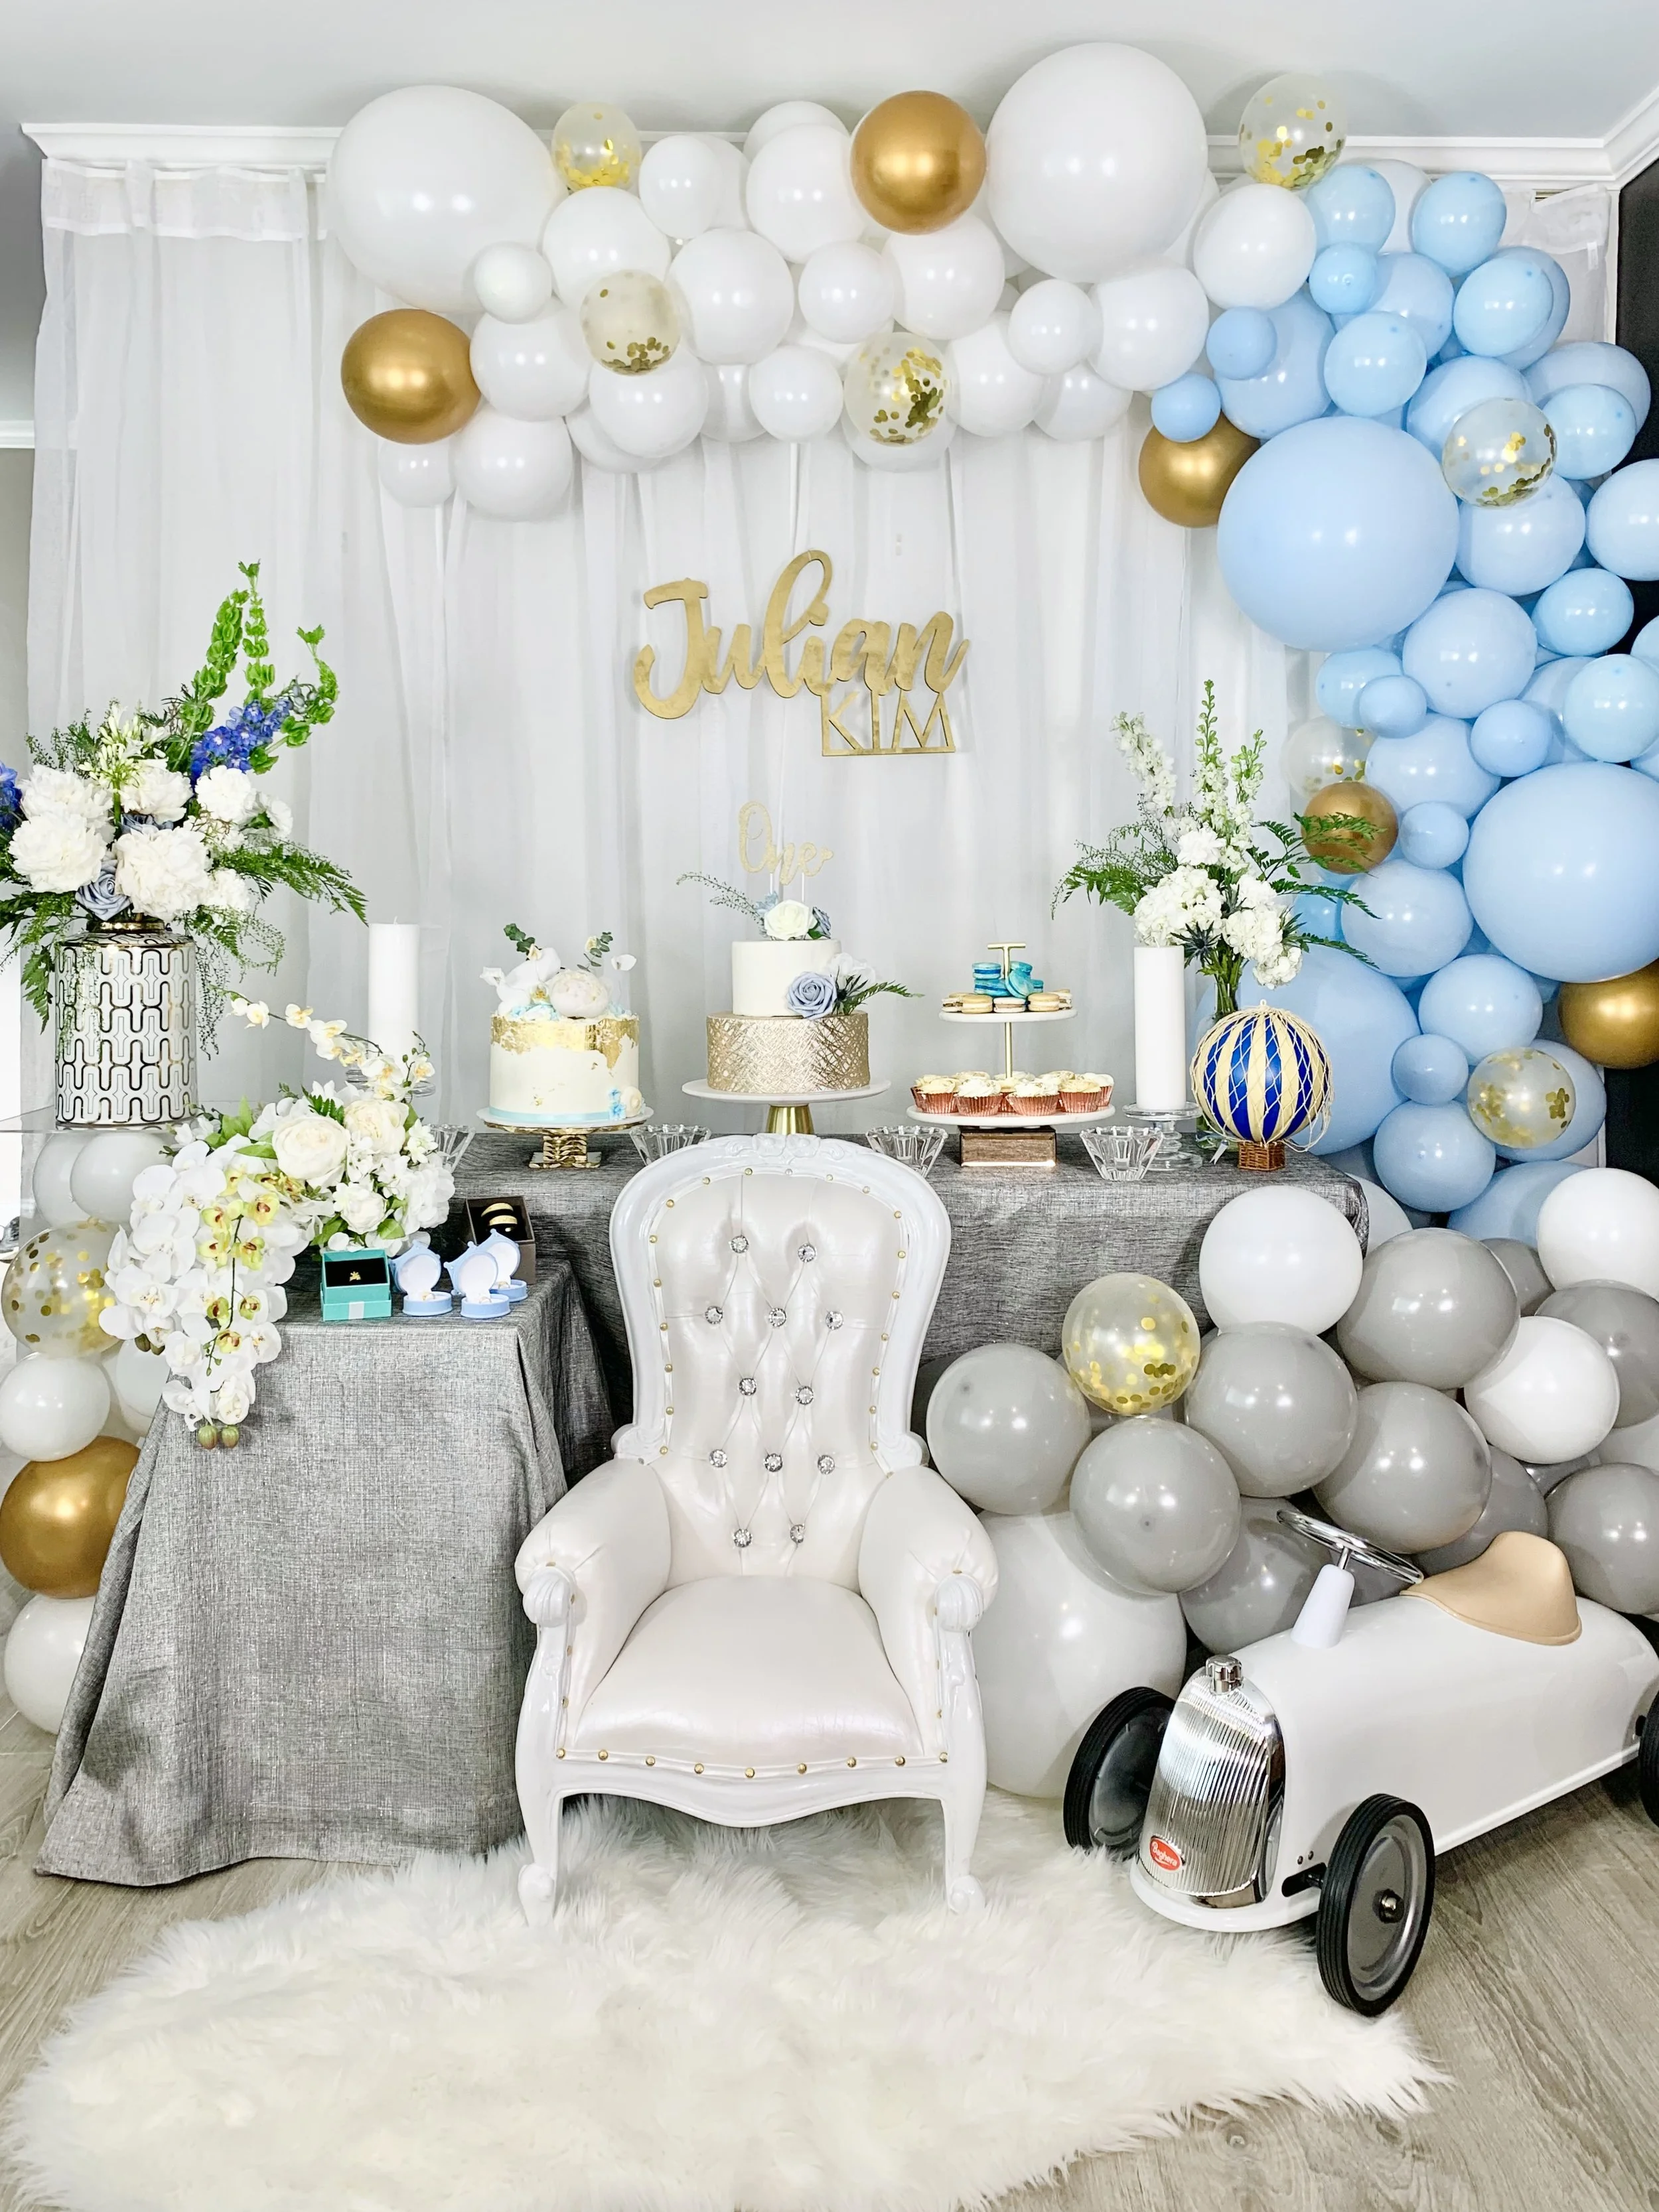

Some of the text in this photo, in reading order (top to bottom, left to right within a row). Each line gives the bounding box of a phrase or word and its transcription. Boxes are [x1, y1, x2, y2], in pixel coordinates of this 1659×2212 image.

[634, 550, 970, 720] Julian
[821, 691, 956, 756] KIM
[738, 801, 834, 886] One
[1151, 1841, 1178, 1866] Baghera
